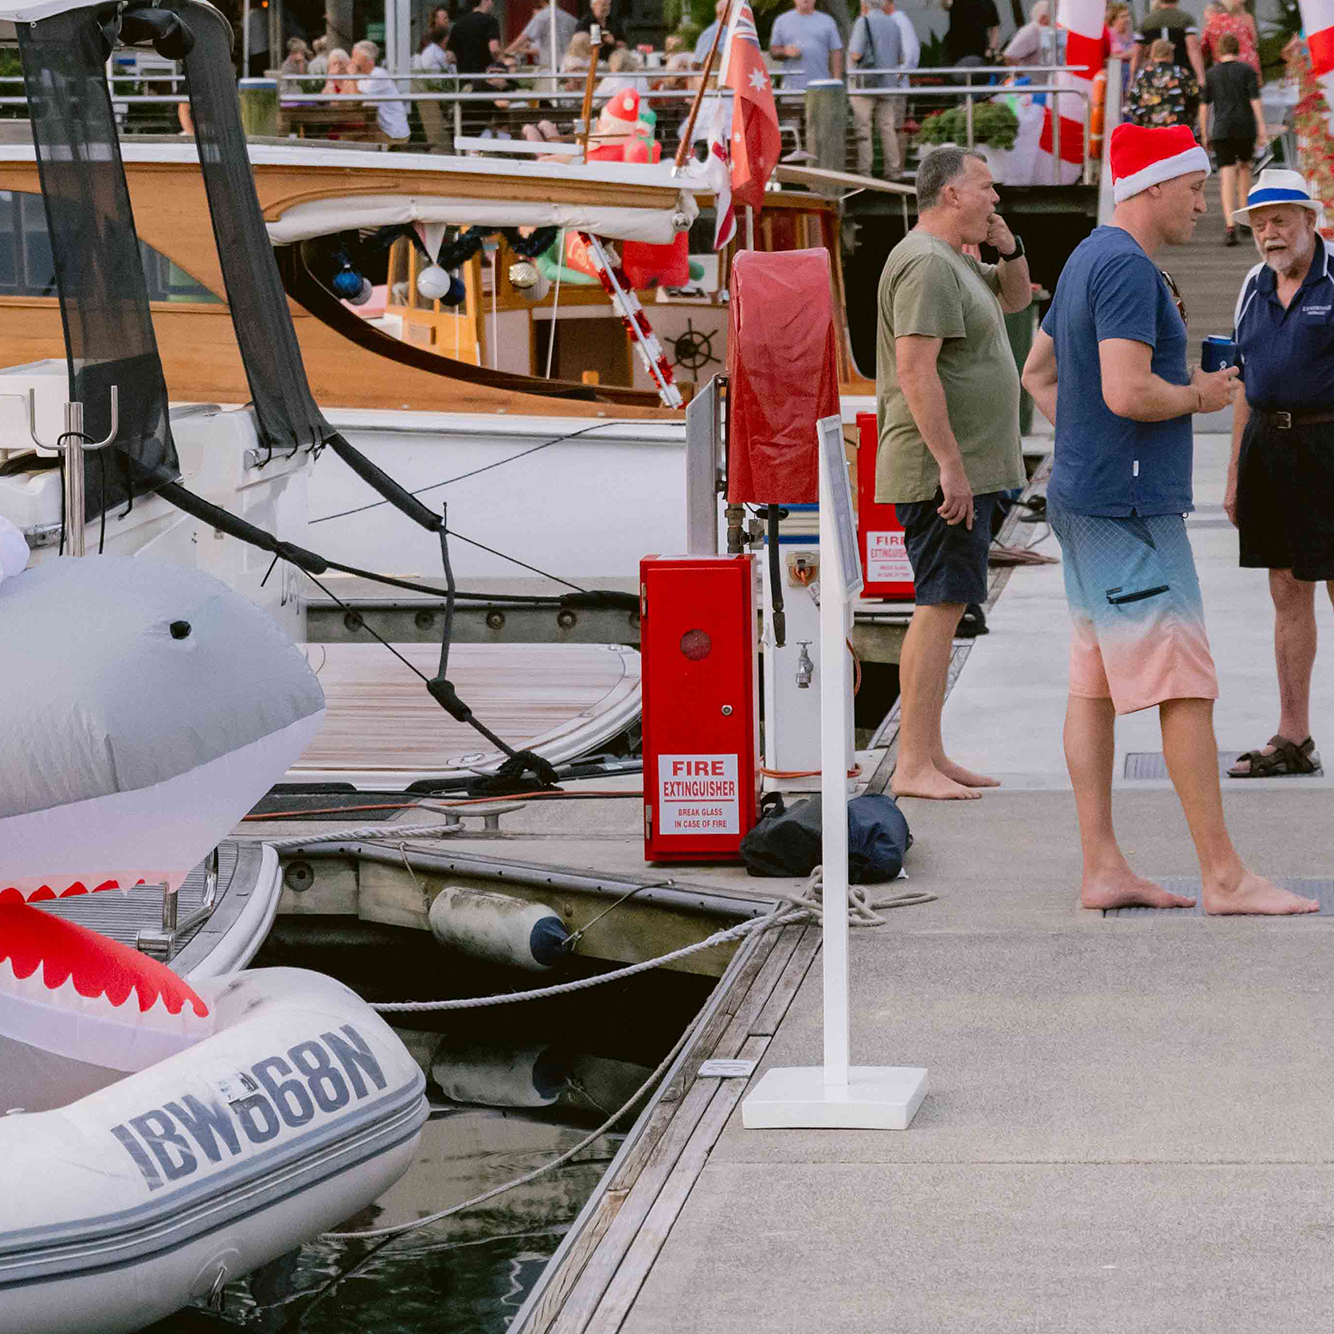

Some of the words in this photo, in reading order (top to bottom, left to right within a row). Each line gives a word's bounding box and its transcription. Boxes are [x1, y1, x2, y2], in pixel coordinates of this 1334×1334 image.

[672, 760, 725, 776] FIRE
[663, 780, 735, 797] EXTINGUISHER
[678, 808, 700, 816] BREAK
[701, 808, 723, 816] GLASS
[674, 820, 682, 828] IN
[683, 820, 701, 828] CASE
[702, 820, 711, 828] OF
[712, 820, 727, 828] FIRE
[110, 1024, 387, 1192] IBW668N
